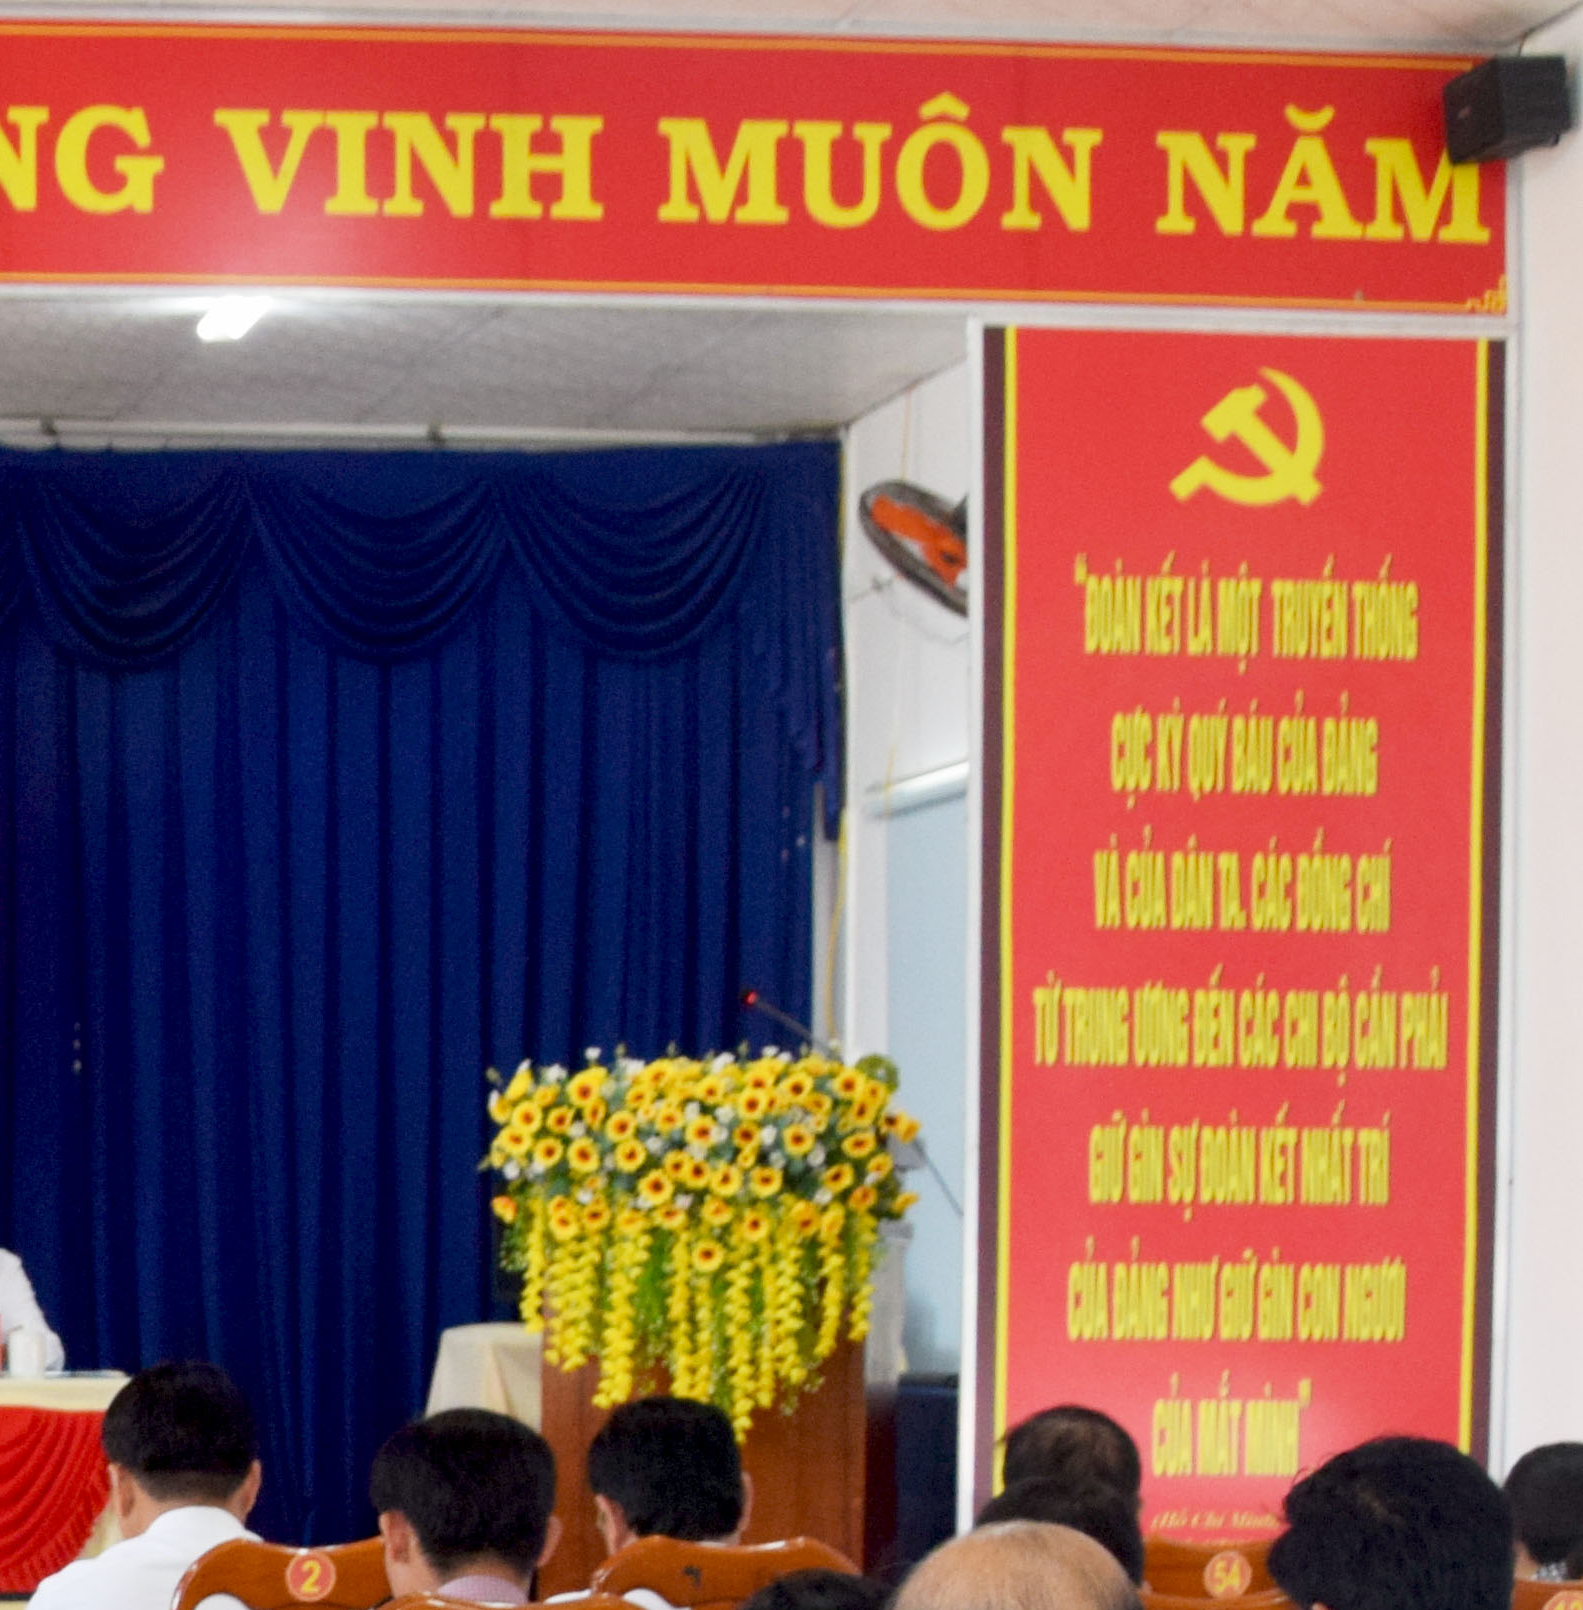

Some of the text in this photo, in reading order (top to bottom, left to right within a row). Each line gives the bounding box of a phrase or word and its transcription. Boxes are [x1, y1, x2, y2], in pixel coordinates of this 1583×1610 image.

[214, 109, 603, 221] VINH
[658, 93, 1102, 230] MUÔN
[1156, 105, 1490, 243] NĂM
[1187, 558, 1213, 656] LÀ
[1217, 561, 1262, 674] MỘT
[301, 1560, 320, 1594] 2
[1214, 1560, 1241, 1592] 54
